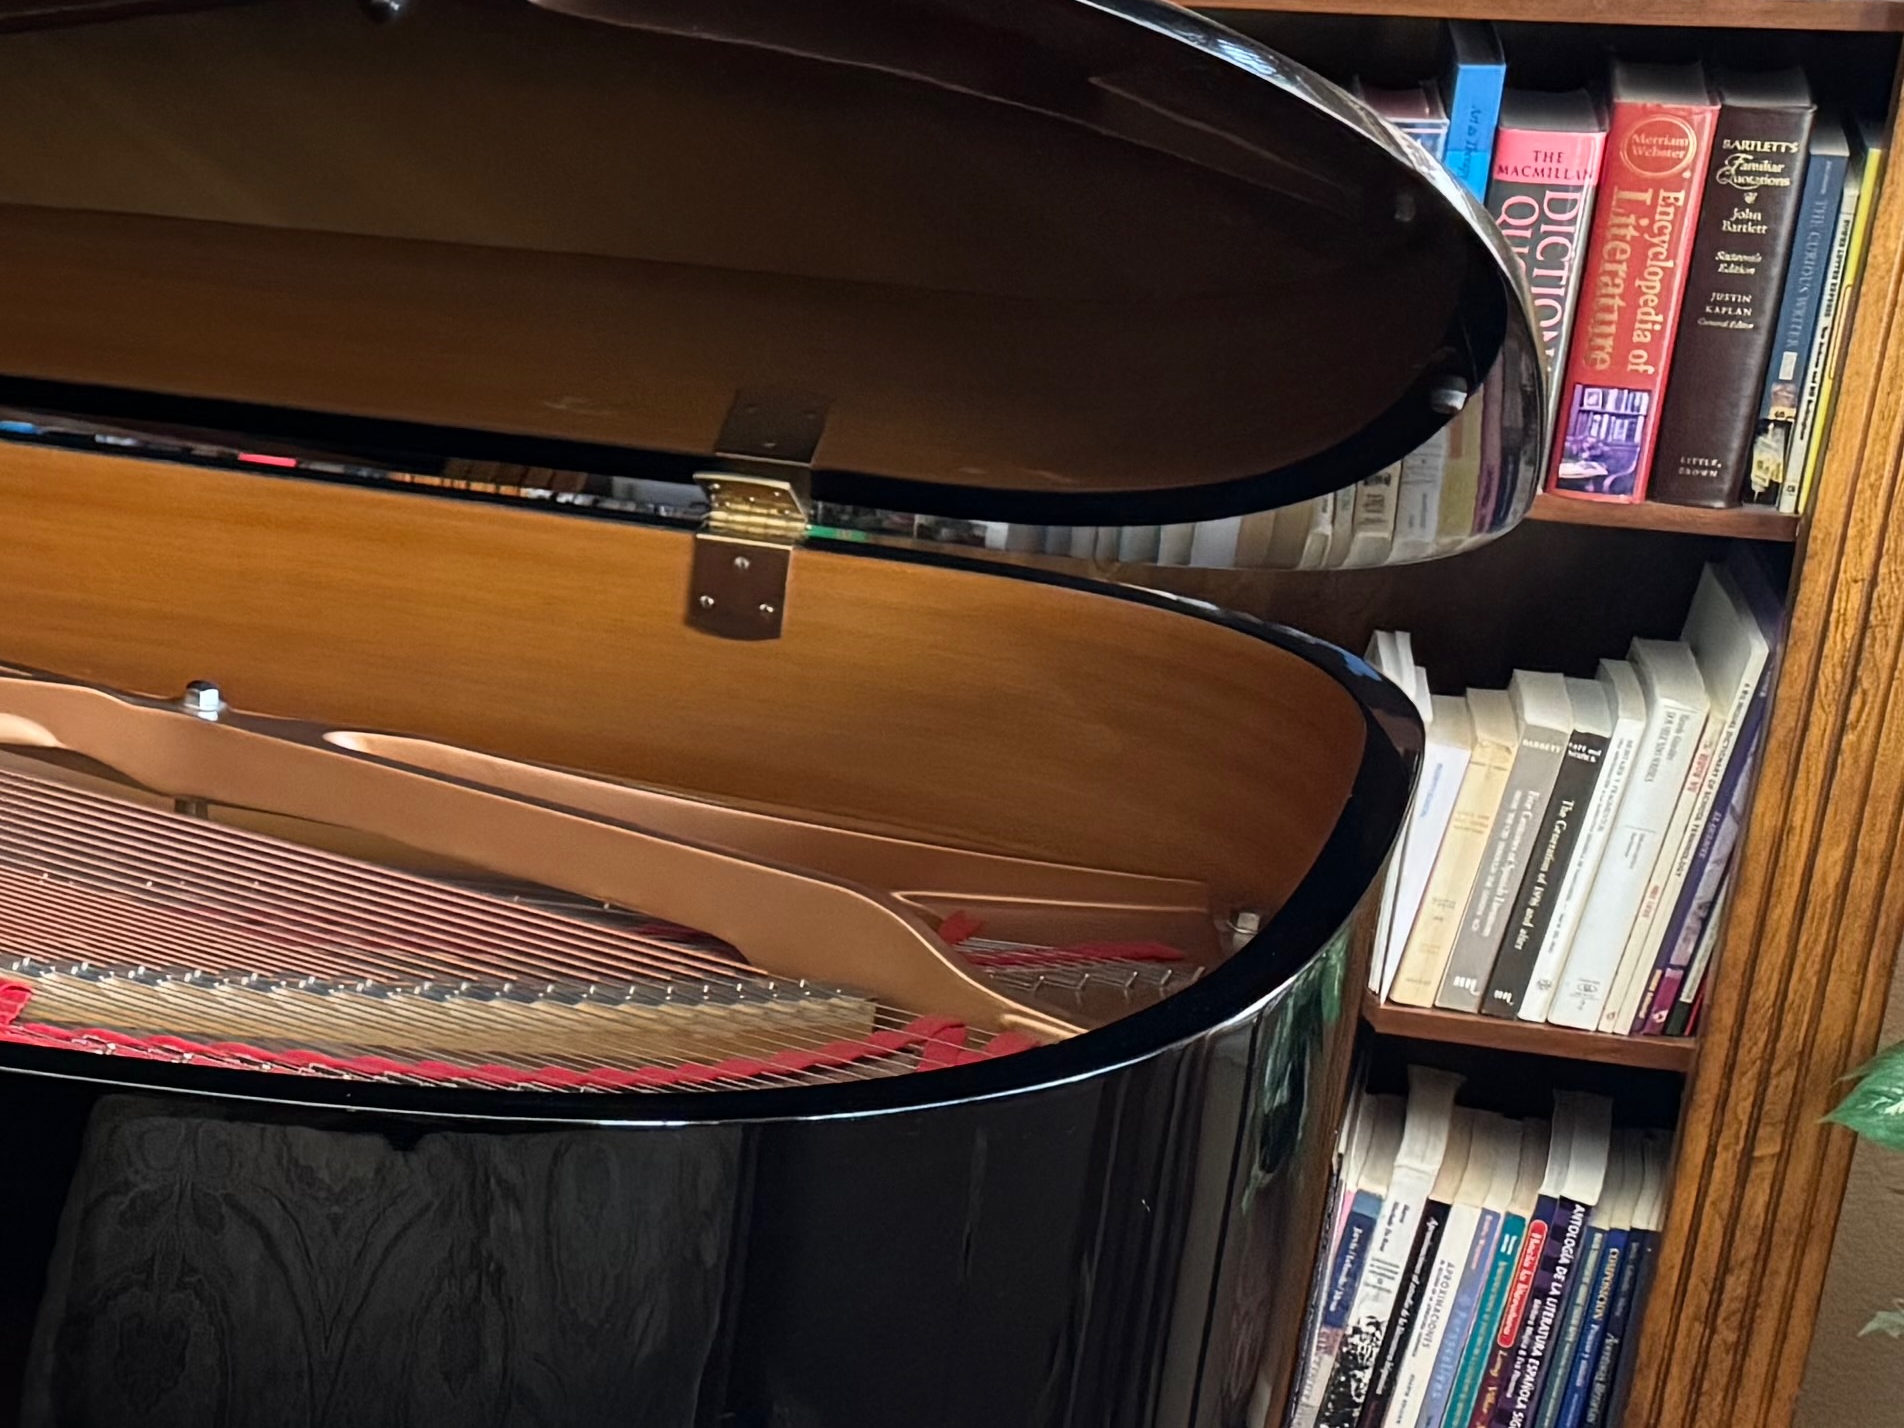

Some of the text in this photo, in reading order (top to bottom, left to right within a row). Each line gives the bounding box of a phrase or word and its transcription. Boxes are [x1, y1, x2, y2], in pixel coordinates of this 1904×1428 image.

[1533, 150, 1564, 164] THE
[1498, 165, 1593, 180] MACMILLAN
[1582, 186, 1655, 370] Literature
[1626, 189, 1685, 375] Encyclopedia of
[1709, 292, 1753, 304] JUSTIN
[1705, 304, 1753, 317] KAPLAN
